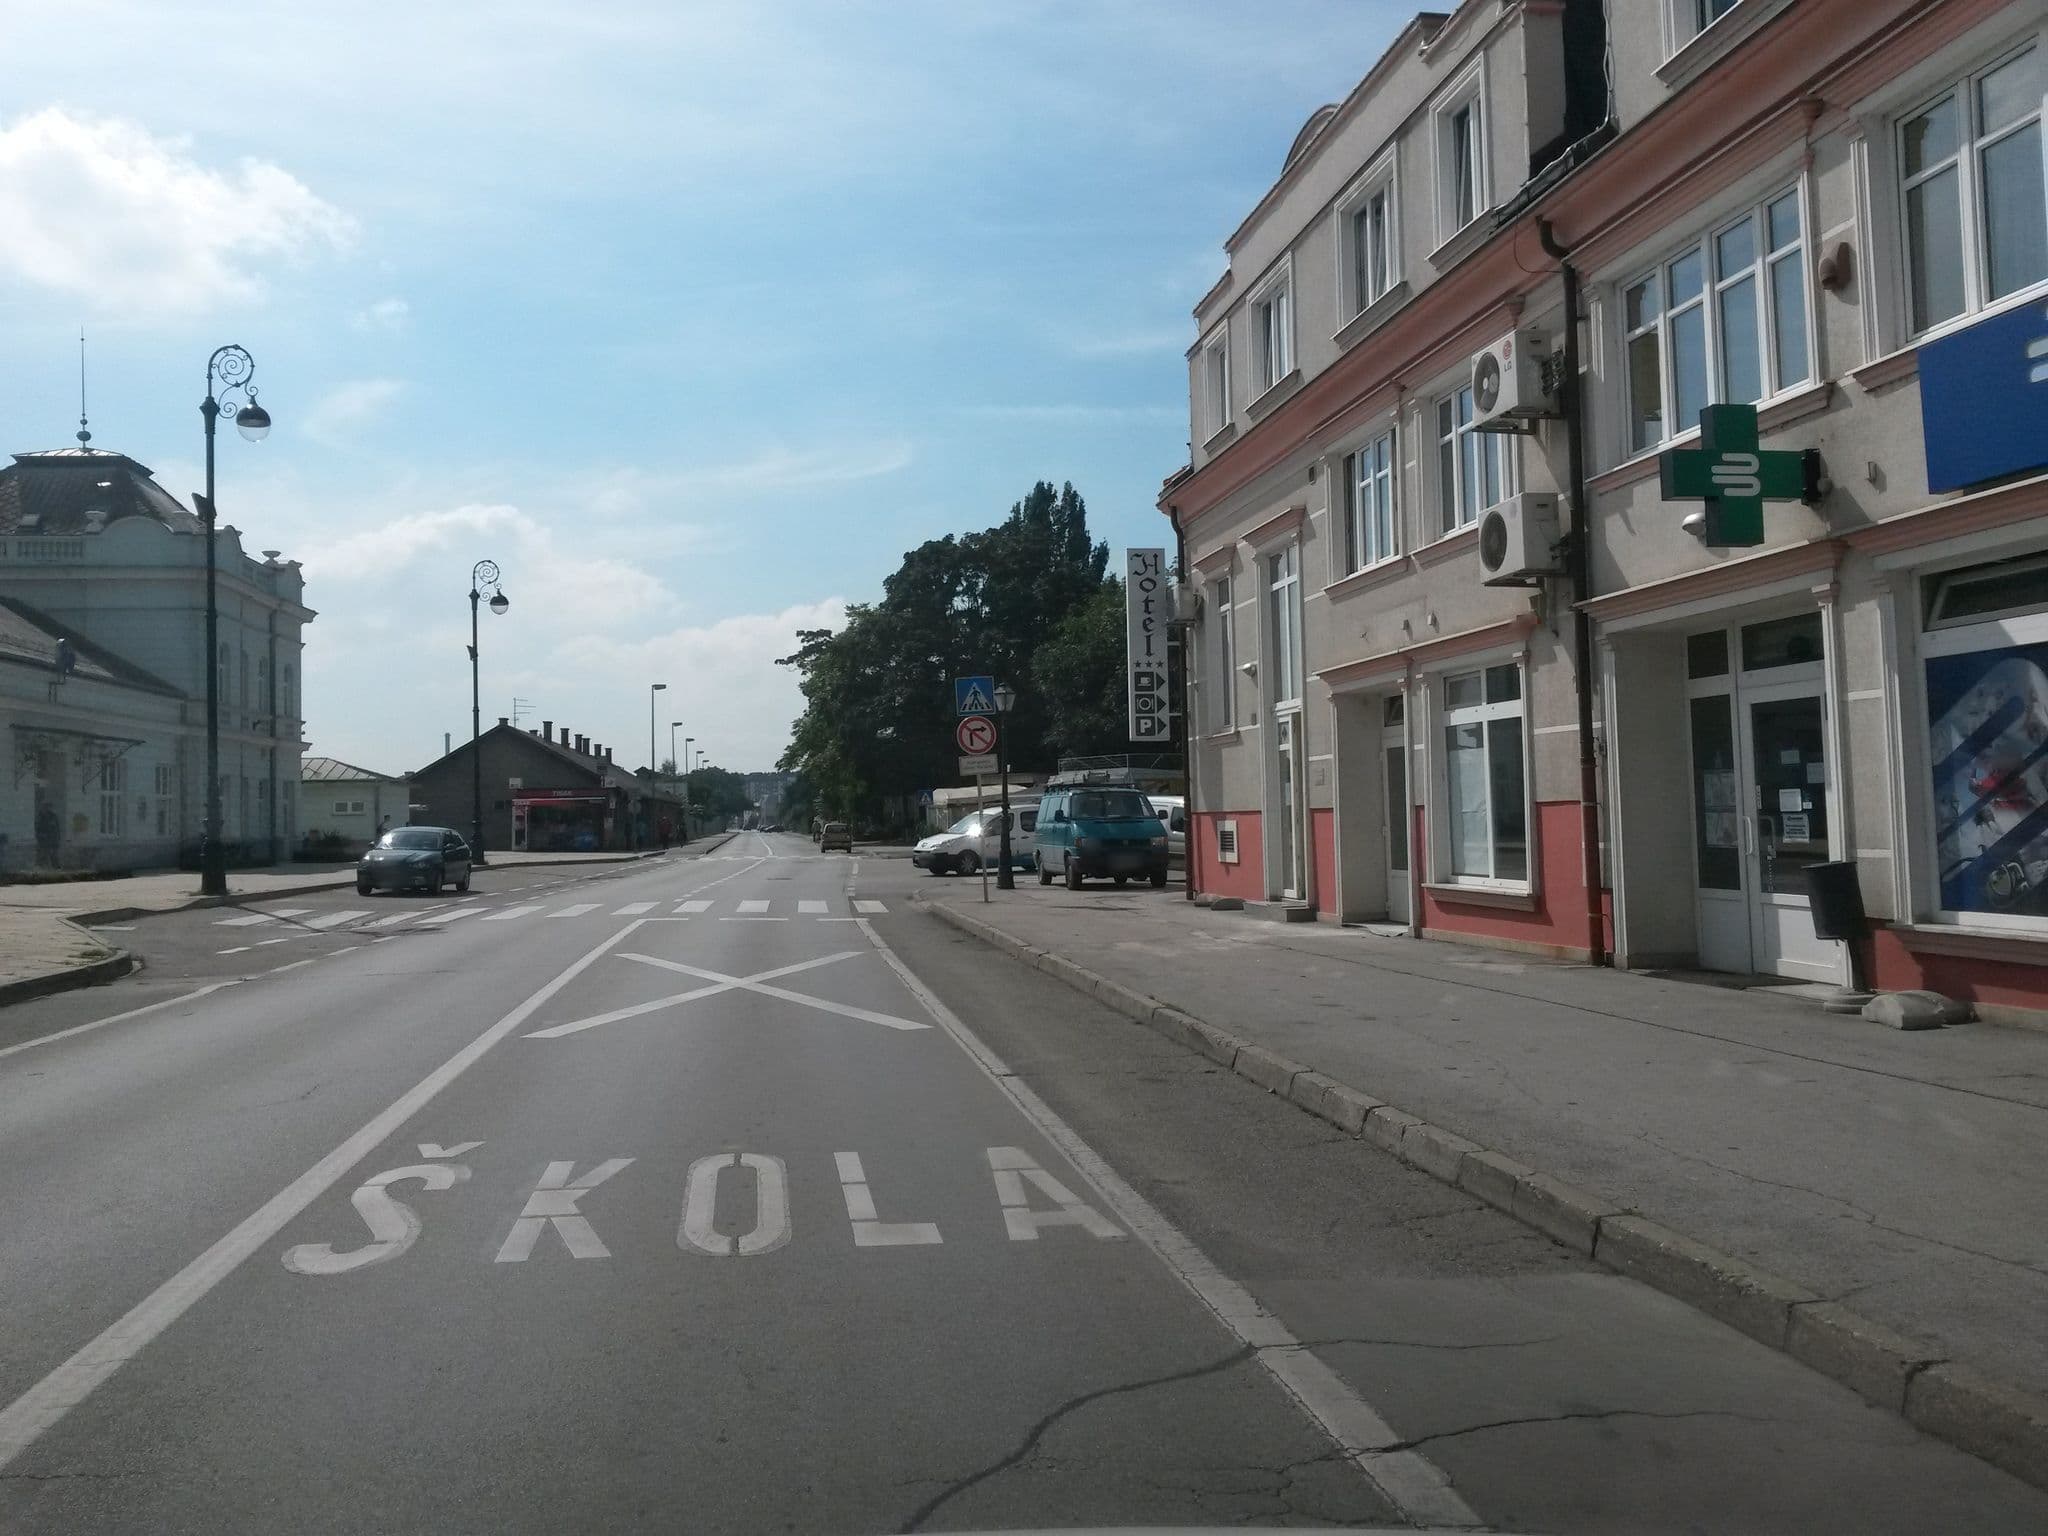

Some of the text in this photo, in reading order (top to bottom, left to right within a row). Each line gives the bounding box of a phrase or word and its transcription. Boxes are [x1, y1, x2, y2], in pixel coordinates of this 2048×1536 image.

[1504, 360, 1512, 372] LG
[1130, 553, 1159, 657] Hotel
[1139, 719, 1152, 734] P
[282, 1141, 1129, 1275] ŠKOLA
